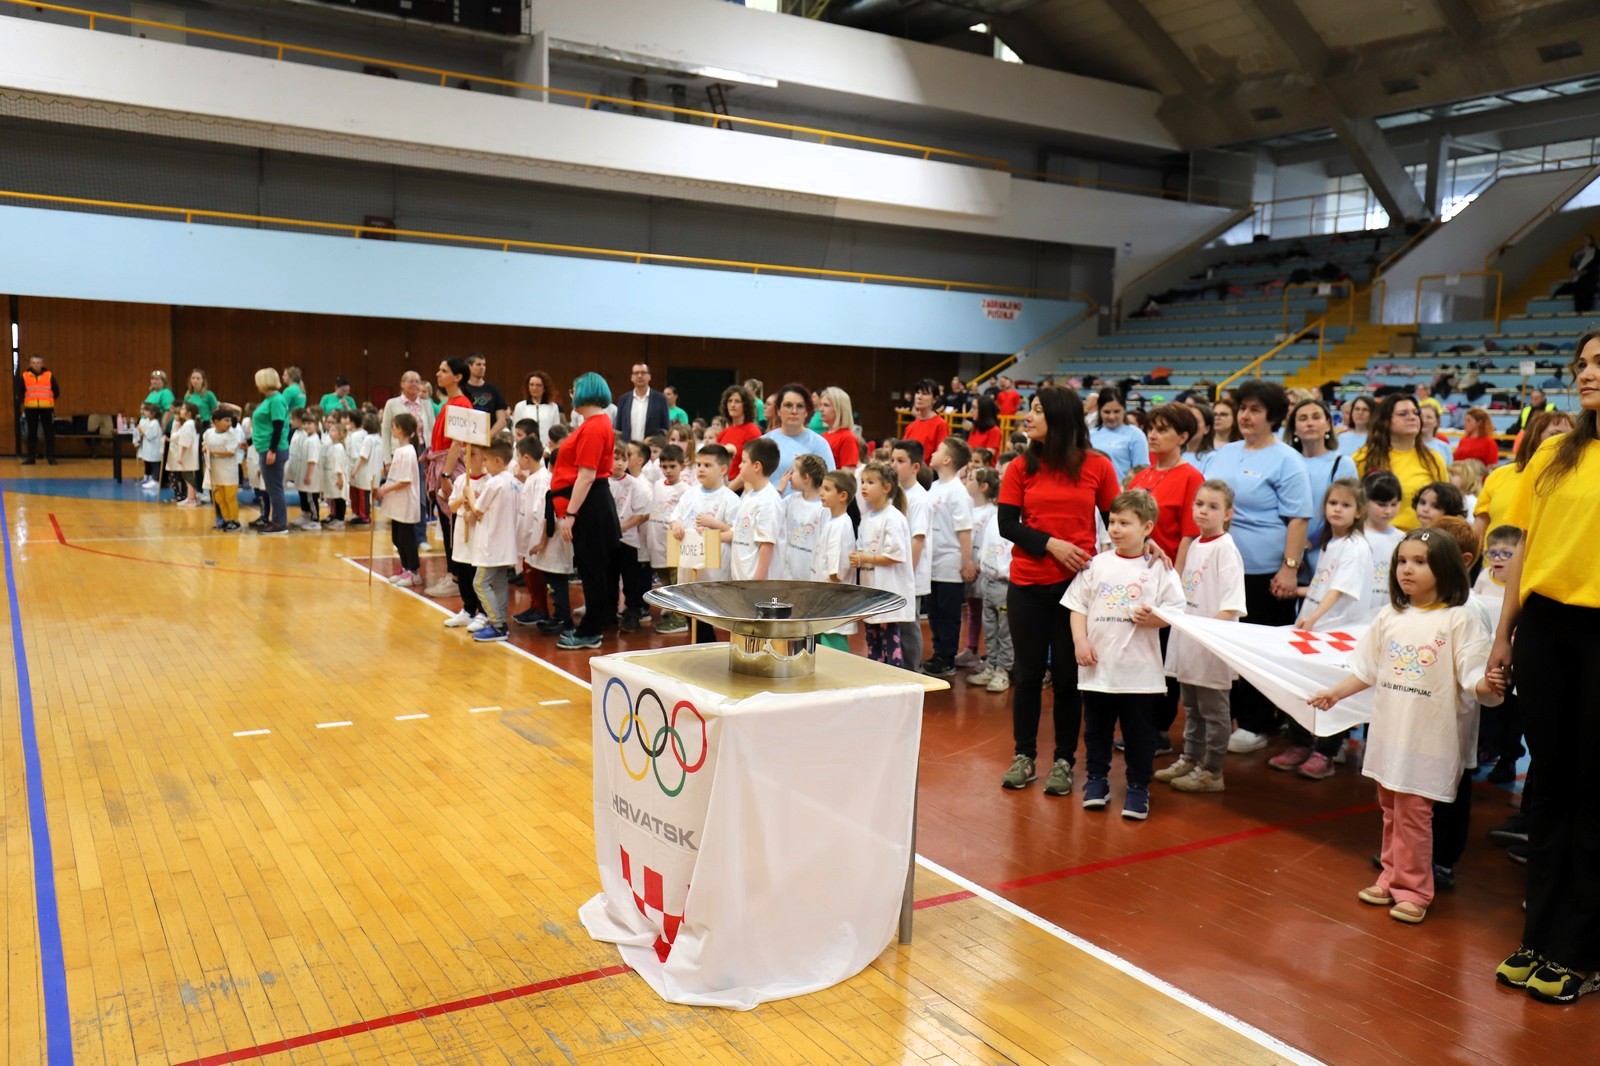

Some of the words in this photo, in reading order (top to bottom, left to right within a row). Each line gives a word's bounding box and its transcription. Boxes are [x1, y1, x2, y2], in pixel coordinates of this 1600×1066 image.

[448, 415, 468, 428] POTOK
[472, 421, 478, 434] 2
[680, 544, 698, 557] MORE
[699, 542, 705, 556] 1
[611, 791, 699, 851] HRVATSK
